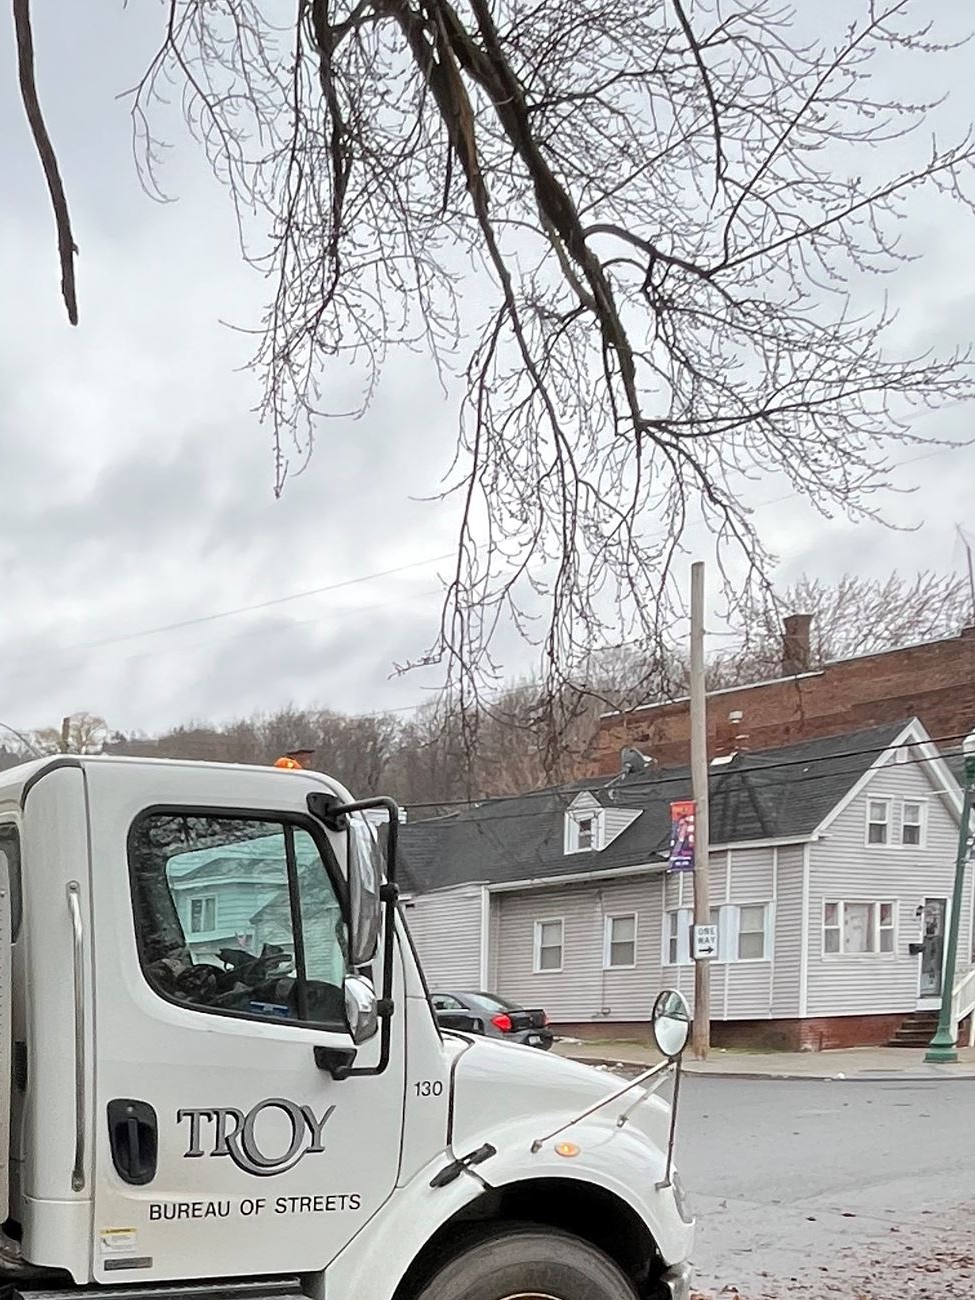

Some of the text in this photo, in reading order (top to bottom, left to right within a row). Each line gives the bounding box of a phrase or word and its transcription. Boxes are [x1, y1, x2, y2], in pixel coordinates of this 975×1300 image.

[698, 927, 715, 936] ONE
[698, 937, 716, 945] WAY
[414, 1080, 443, 1097] 130
[176, 1098, 337, 1177] TROY
[149, 1194, 361, 1221] BUREAU OF STREETS
